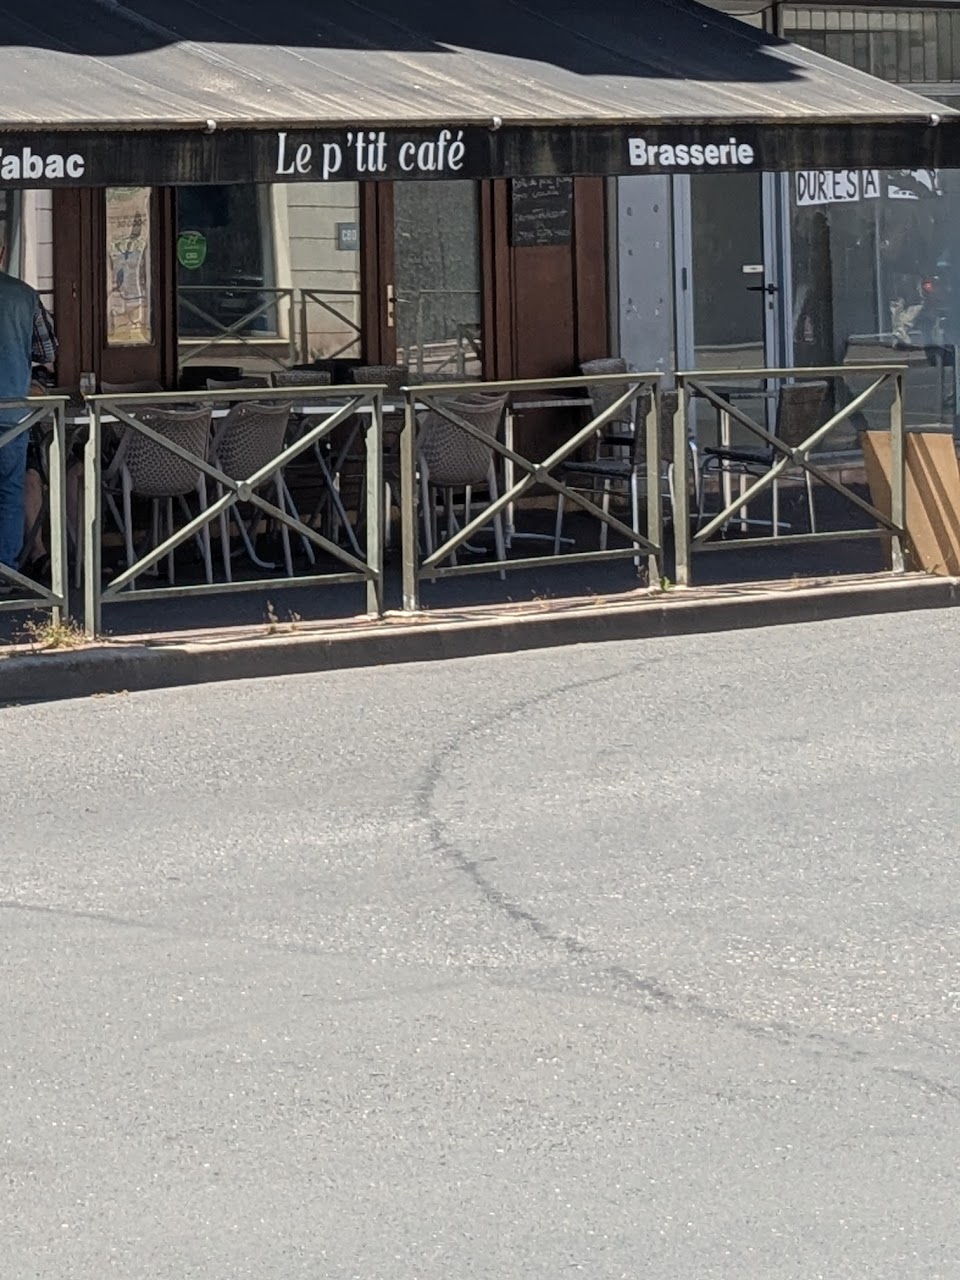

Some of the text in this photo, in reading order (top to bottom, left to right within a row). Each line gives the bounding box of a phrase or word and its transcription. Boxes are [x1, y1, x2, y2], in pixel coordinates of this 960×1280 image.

[276, 129, 465, 180] Le p'tit café
[628, 137, 754, 166] Brasserie
